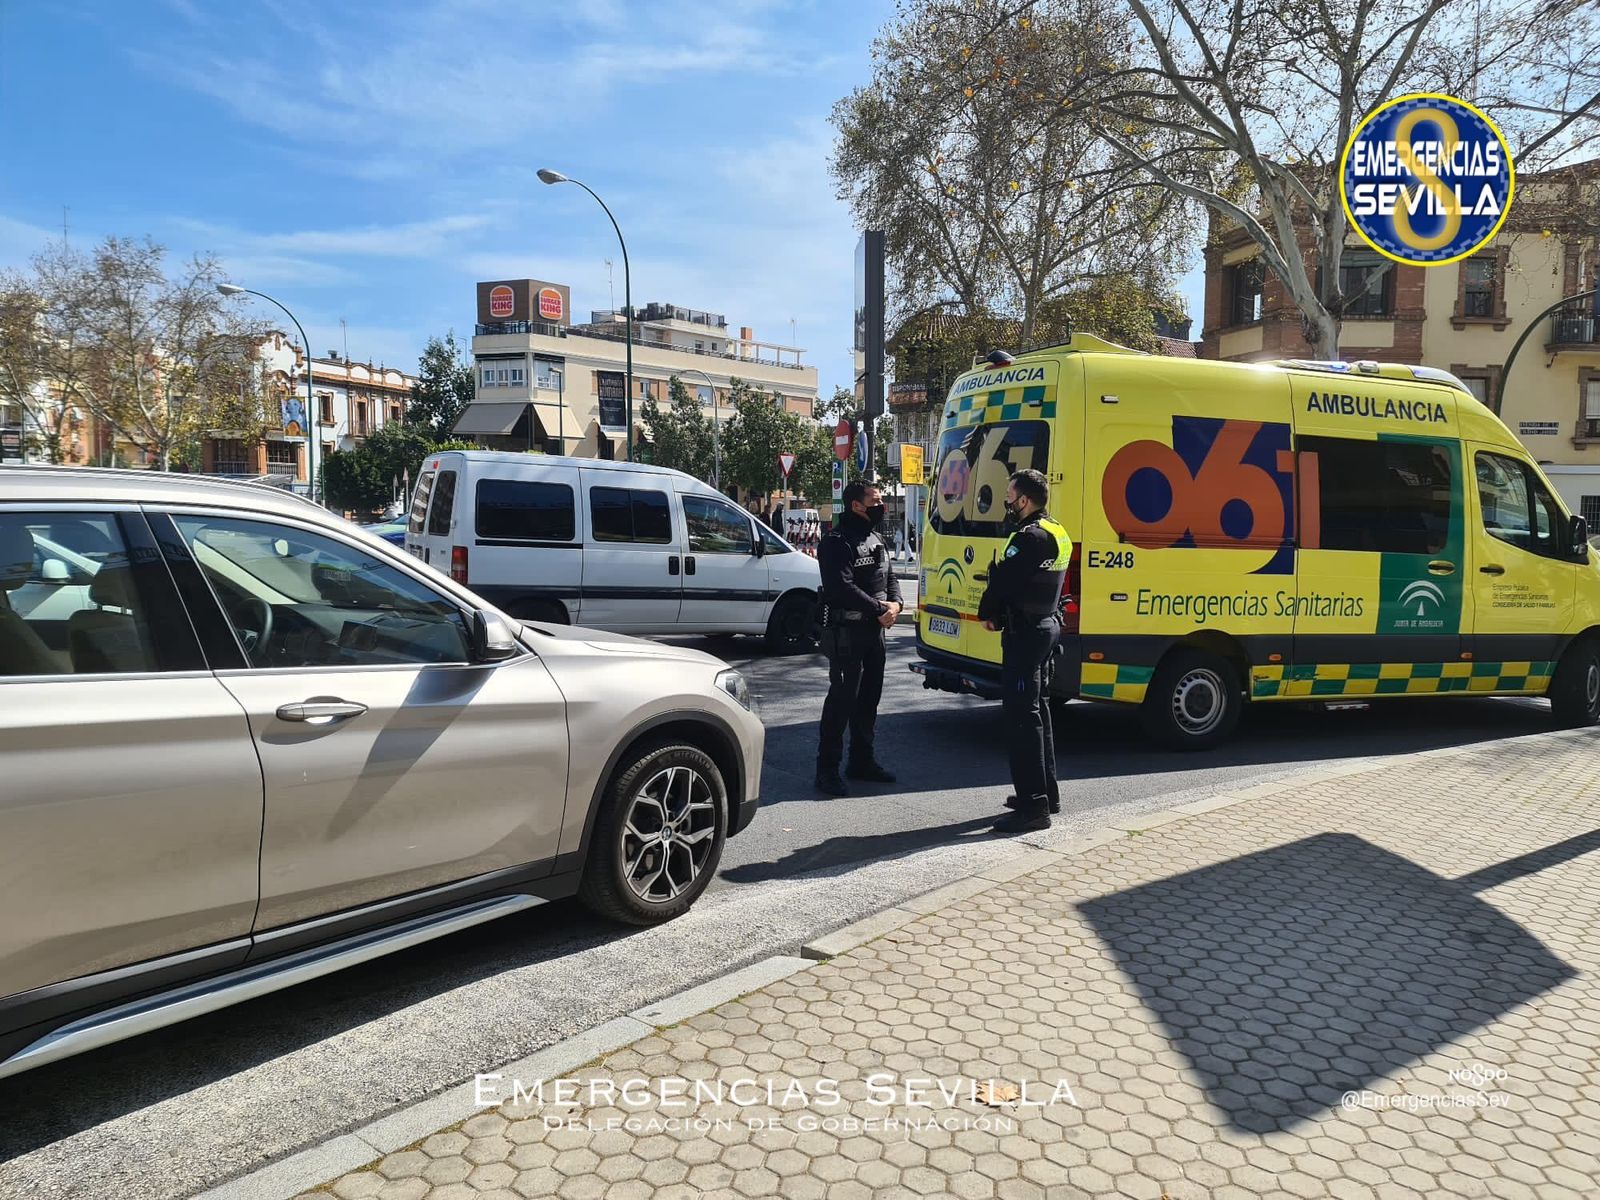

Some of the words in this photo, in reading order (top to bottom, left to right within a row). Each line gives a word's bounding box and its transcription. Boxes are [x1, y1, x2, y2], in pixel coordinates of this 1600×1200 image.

[492, 301, 513, 311] KING
[541, 303, 562, 313] KING
[953, 367, 1045, 395] AMBULANCIA
[1307, 391, 1448, 423] AMBULANCIA
[1101, 419, 1320, 550] 061
[1088, 551, 1135, 569] E-248
[1136, 589, 1268, 623] Emergencias
[1274, 591, 1364, 618] Sanitarias
